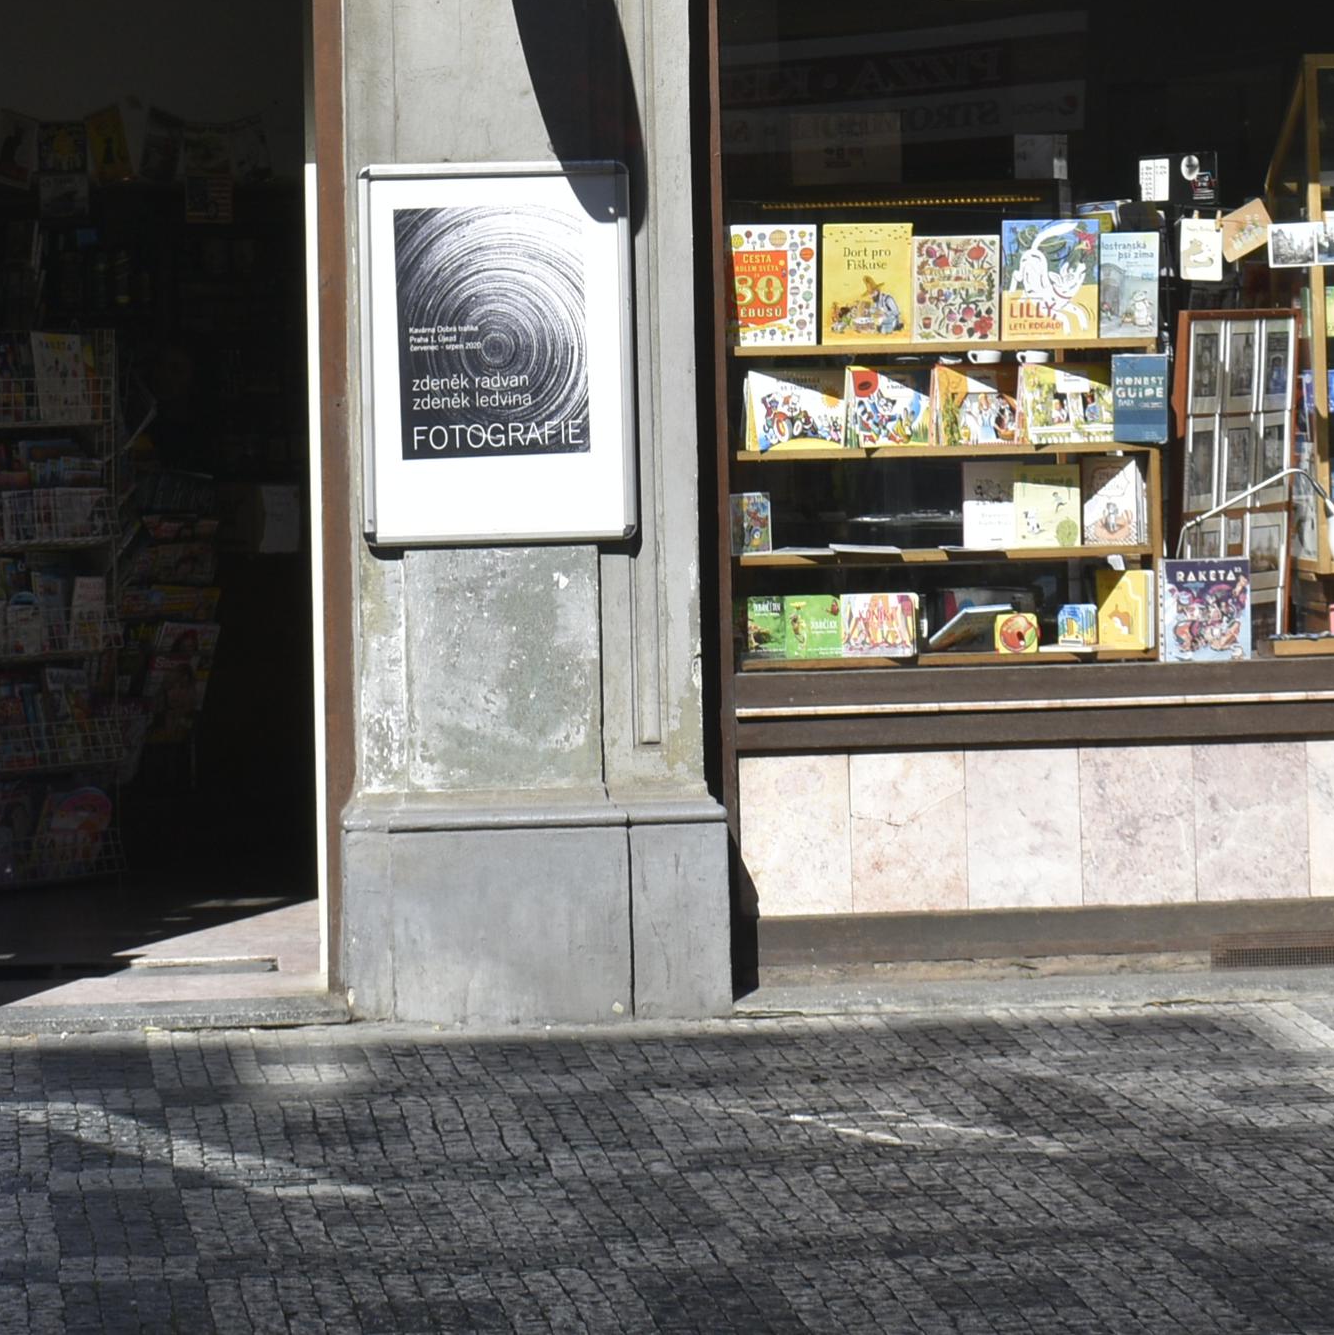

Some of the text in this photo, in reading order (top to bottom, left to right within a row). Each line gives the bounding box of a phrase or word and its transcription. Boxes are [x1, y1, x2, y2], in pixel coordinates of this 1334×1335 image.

[742, 254, 772, 264] CESTA
[843, 247, 891, 259] Dort pro
[1133, 250, 1155, 259] zima
[1009, 301, 1057, 321] LILLY,
[437, 325, 457, 333] Dobrá
[465, 341, 482, 350] 2020
[412, 373, 529, 391] zdeněk radvan
[1115, 376, 1165, 386] HONEST
[412, 392, 532, 411] zdeněk ledvina
[412, 419, 584, 450] FOTOGRAFIE
[1175, 568, 1236, 583] RAKETA
